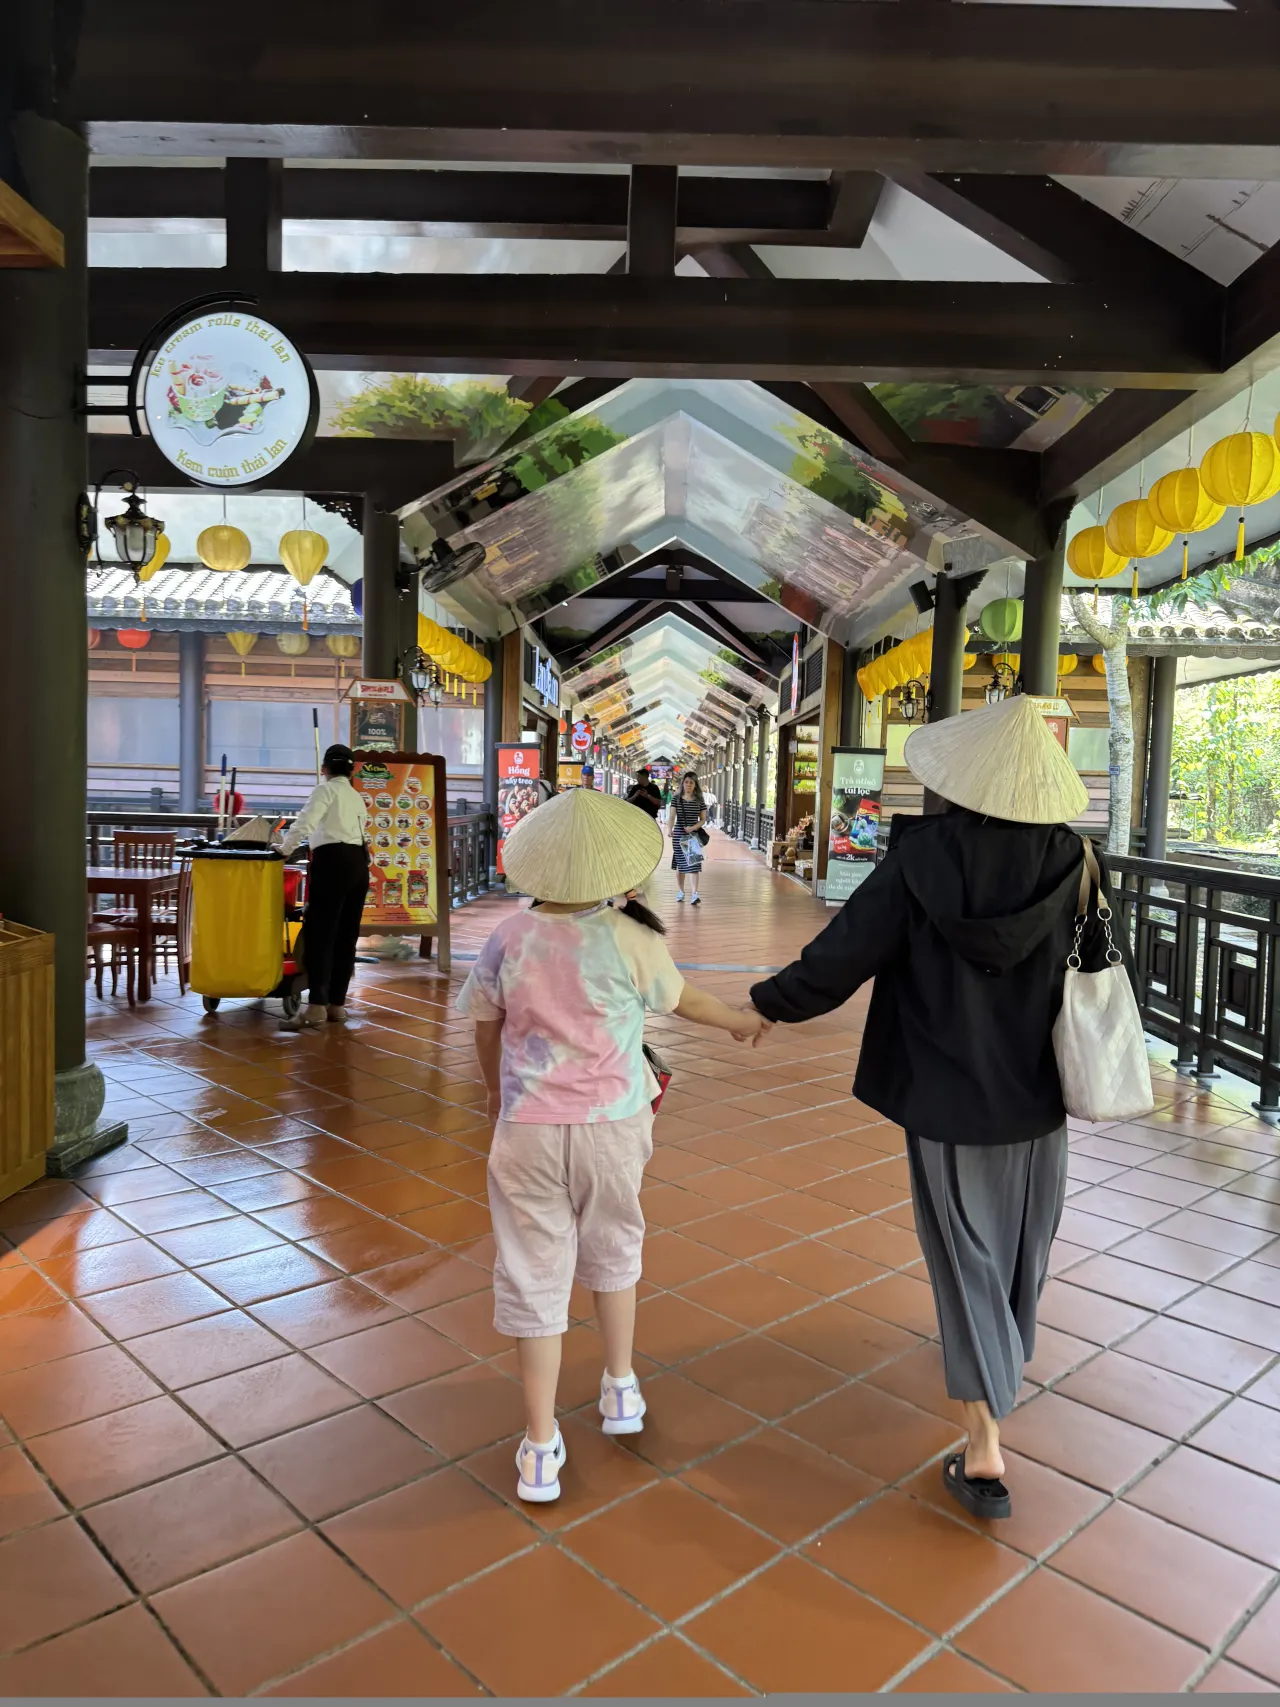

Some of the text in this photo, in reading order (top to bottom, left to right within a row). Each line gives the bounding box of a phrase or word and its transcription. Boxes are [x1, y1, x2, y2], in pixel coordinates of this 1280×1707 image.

[165, 323, 202, 353] cream
[207, 314, 241, 327] rolls
[271, 339, 291, 363] lan
[176, 448, 204, 474] Kem
[264, 439, 288, 459] lan
[508, 765, 530, 777] Hồng
[518, 777, 533, 785] treo
[840, 776, 854, 785] Trà
[844, 786, 870, 796] túi lọc
[846, 853, 855, 861] 2k
